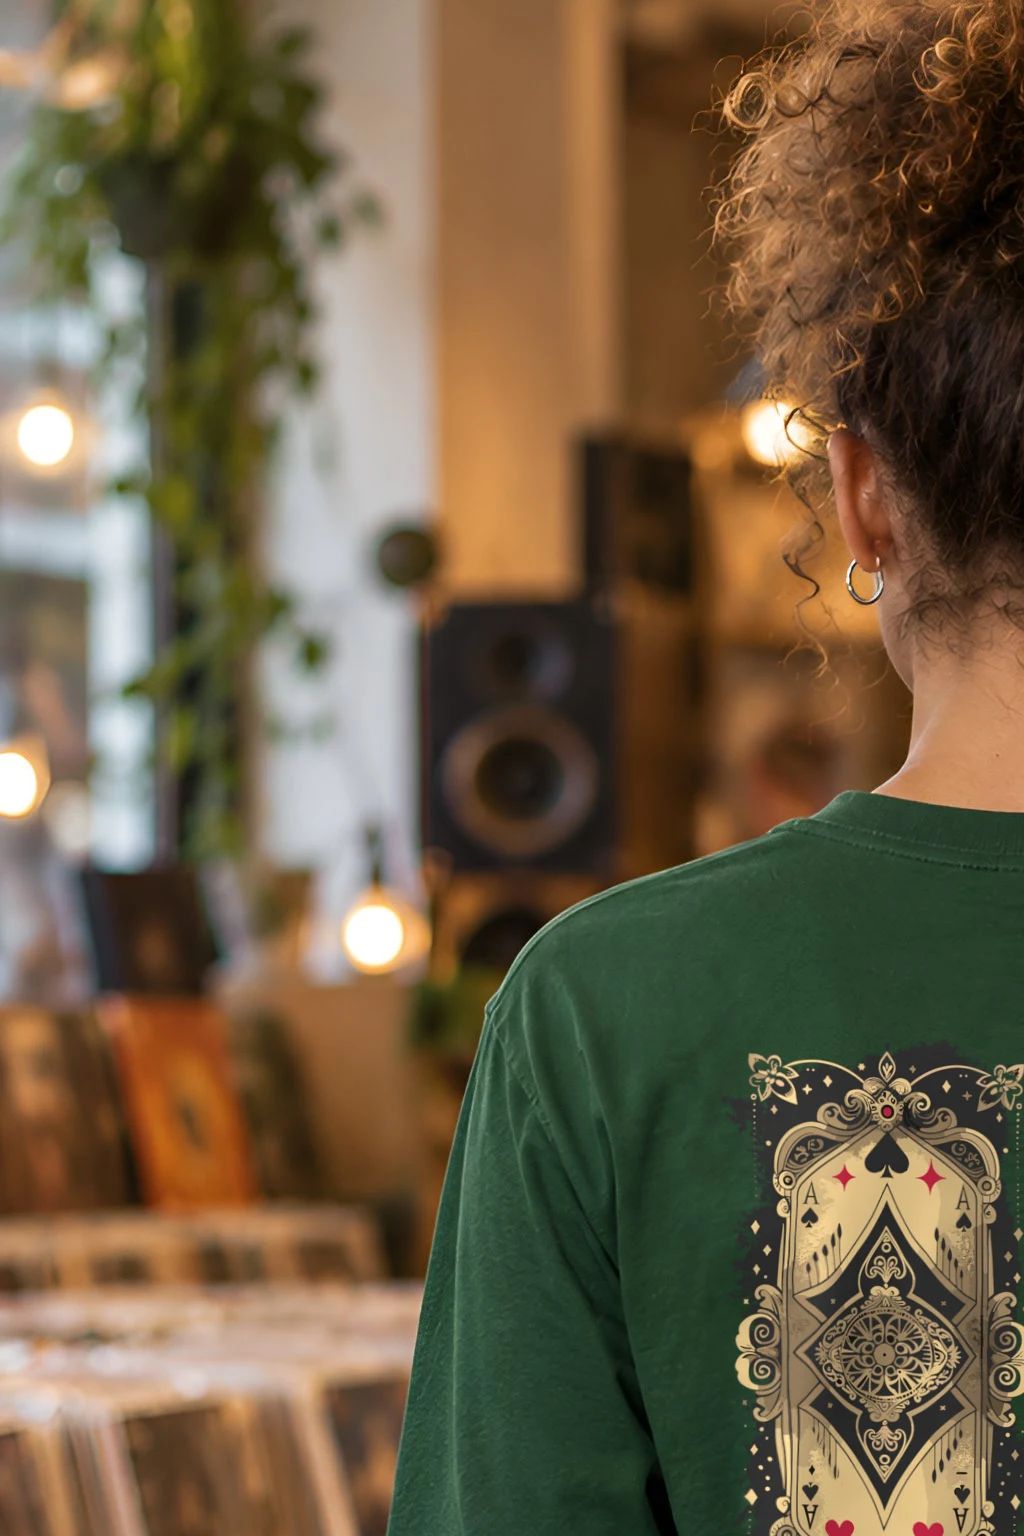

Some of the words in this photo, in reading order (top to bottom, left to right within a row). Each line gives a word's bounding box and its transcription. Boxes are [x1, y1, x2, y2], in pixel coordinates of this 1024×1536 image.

[802, 1180, 820, 1205] A
[954, 1184, 971, 1210] A
[802, 1503, 820, 1530] A
[952, 1507, 970, 1534] A
